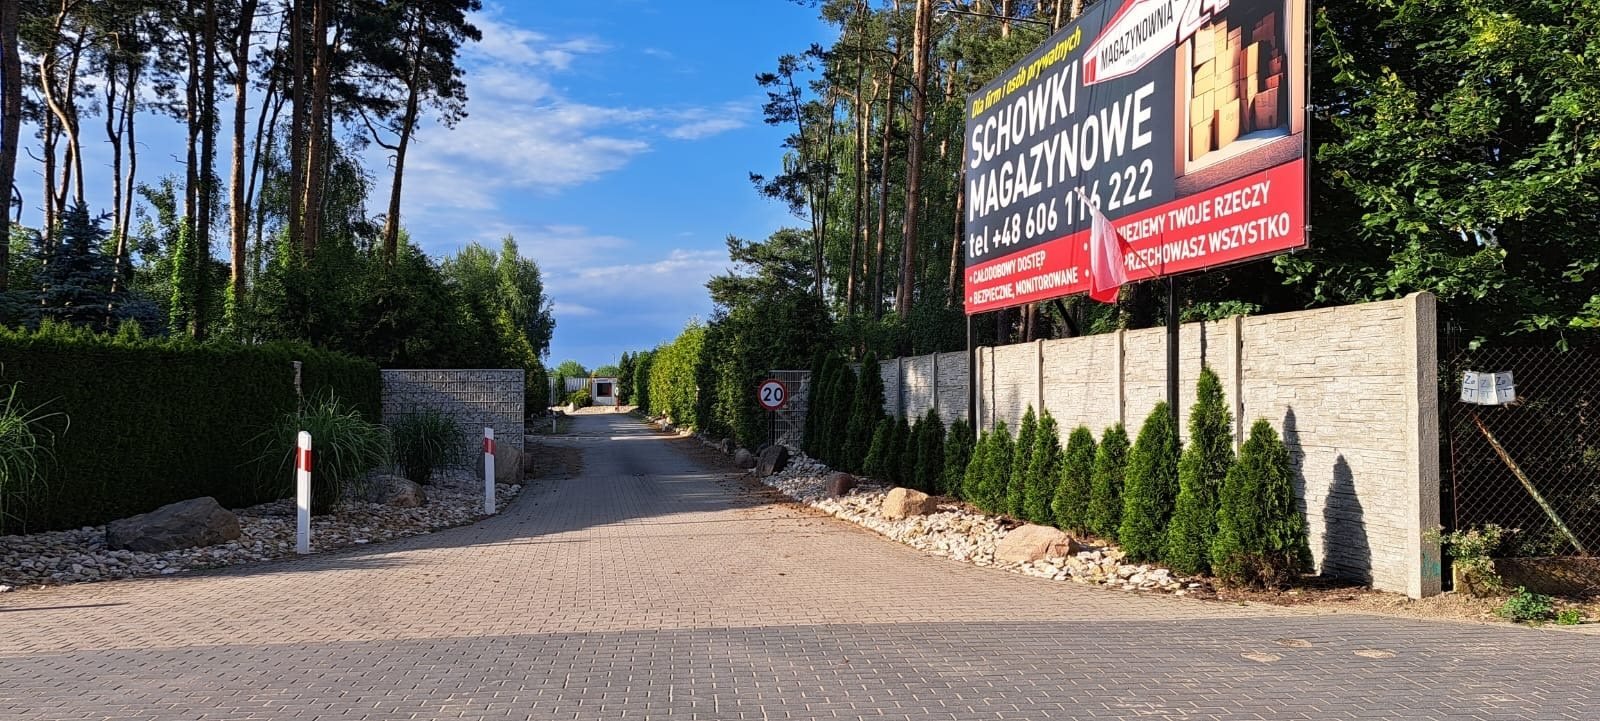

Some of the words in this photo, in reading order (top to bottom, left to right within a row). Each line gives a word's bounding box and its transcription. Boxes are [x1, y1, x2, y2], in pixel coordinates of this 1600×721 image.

[1101, 0, 1174, 72] MAGAZYNOWNIA
[971, 99, 984, 119] Dla
[985, 87, 1002, 111] firm
[1002, 81, 1007, 97] i
[1006, 66, 1026, 92] osób
[1026, 25, 1082, 86] prywatnych
[970, 59, 1079, 169] SCHOWKI
[969, 81, 1155, 222] MAGAZYNOWE
[969, 225, 989, 258] tel
[992, 213, 1021, 249] +48
[1026, 197, 1058, 239] 606
[1064, 179, 1101, 225] 116
[1108, 158, 1153, 211] 222
[1168, 199, 1212, 230] TWOJE
[1214, 179, 1271, 218] RZECZY
[1209, 212, 1290, 254] WSZYSTKO
[973, 257, 1017, 284] CAŁODOBOWY
[1017, 250, 1046, 271] DOSTĘP
[973, 282, 1015, 305] BEZPIECZNE,
[1016, 266, 1079, 296] MONITOROWANE
[763, 387, 783, 402] 20
